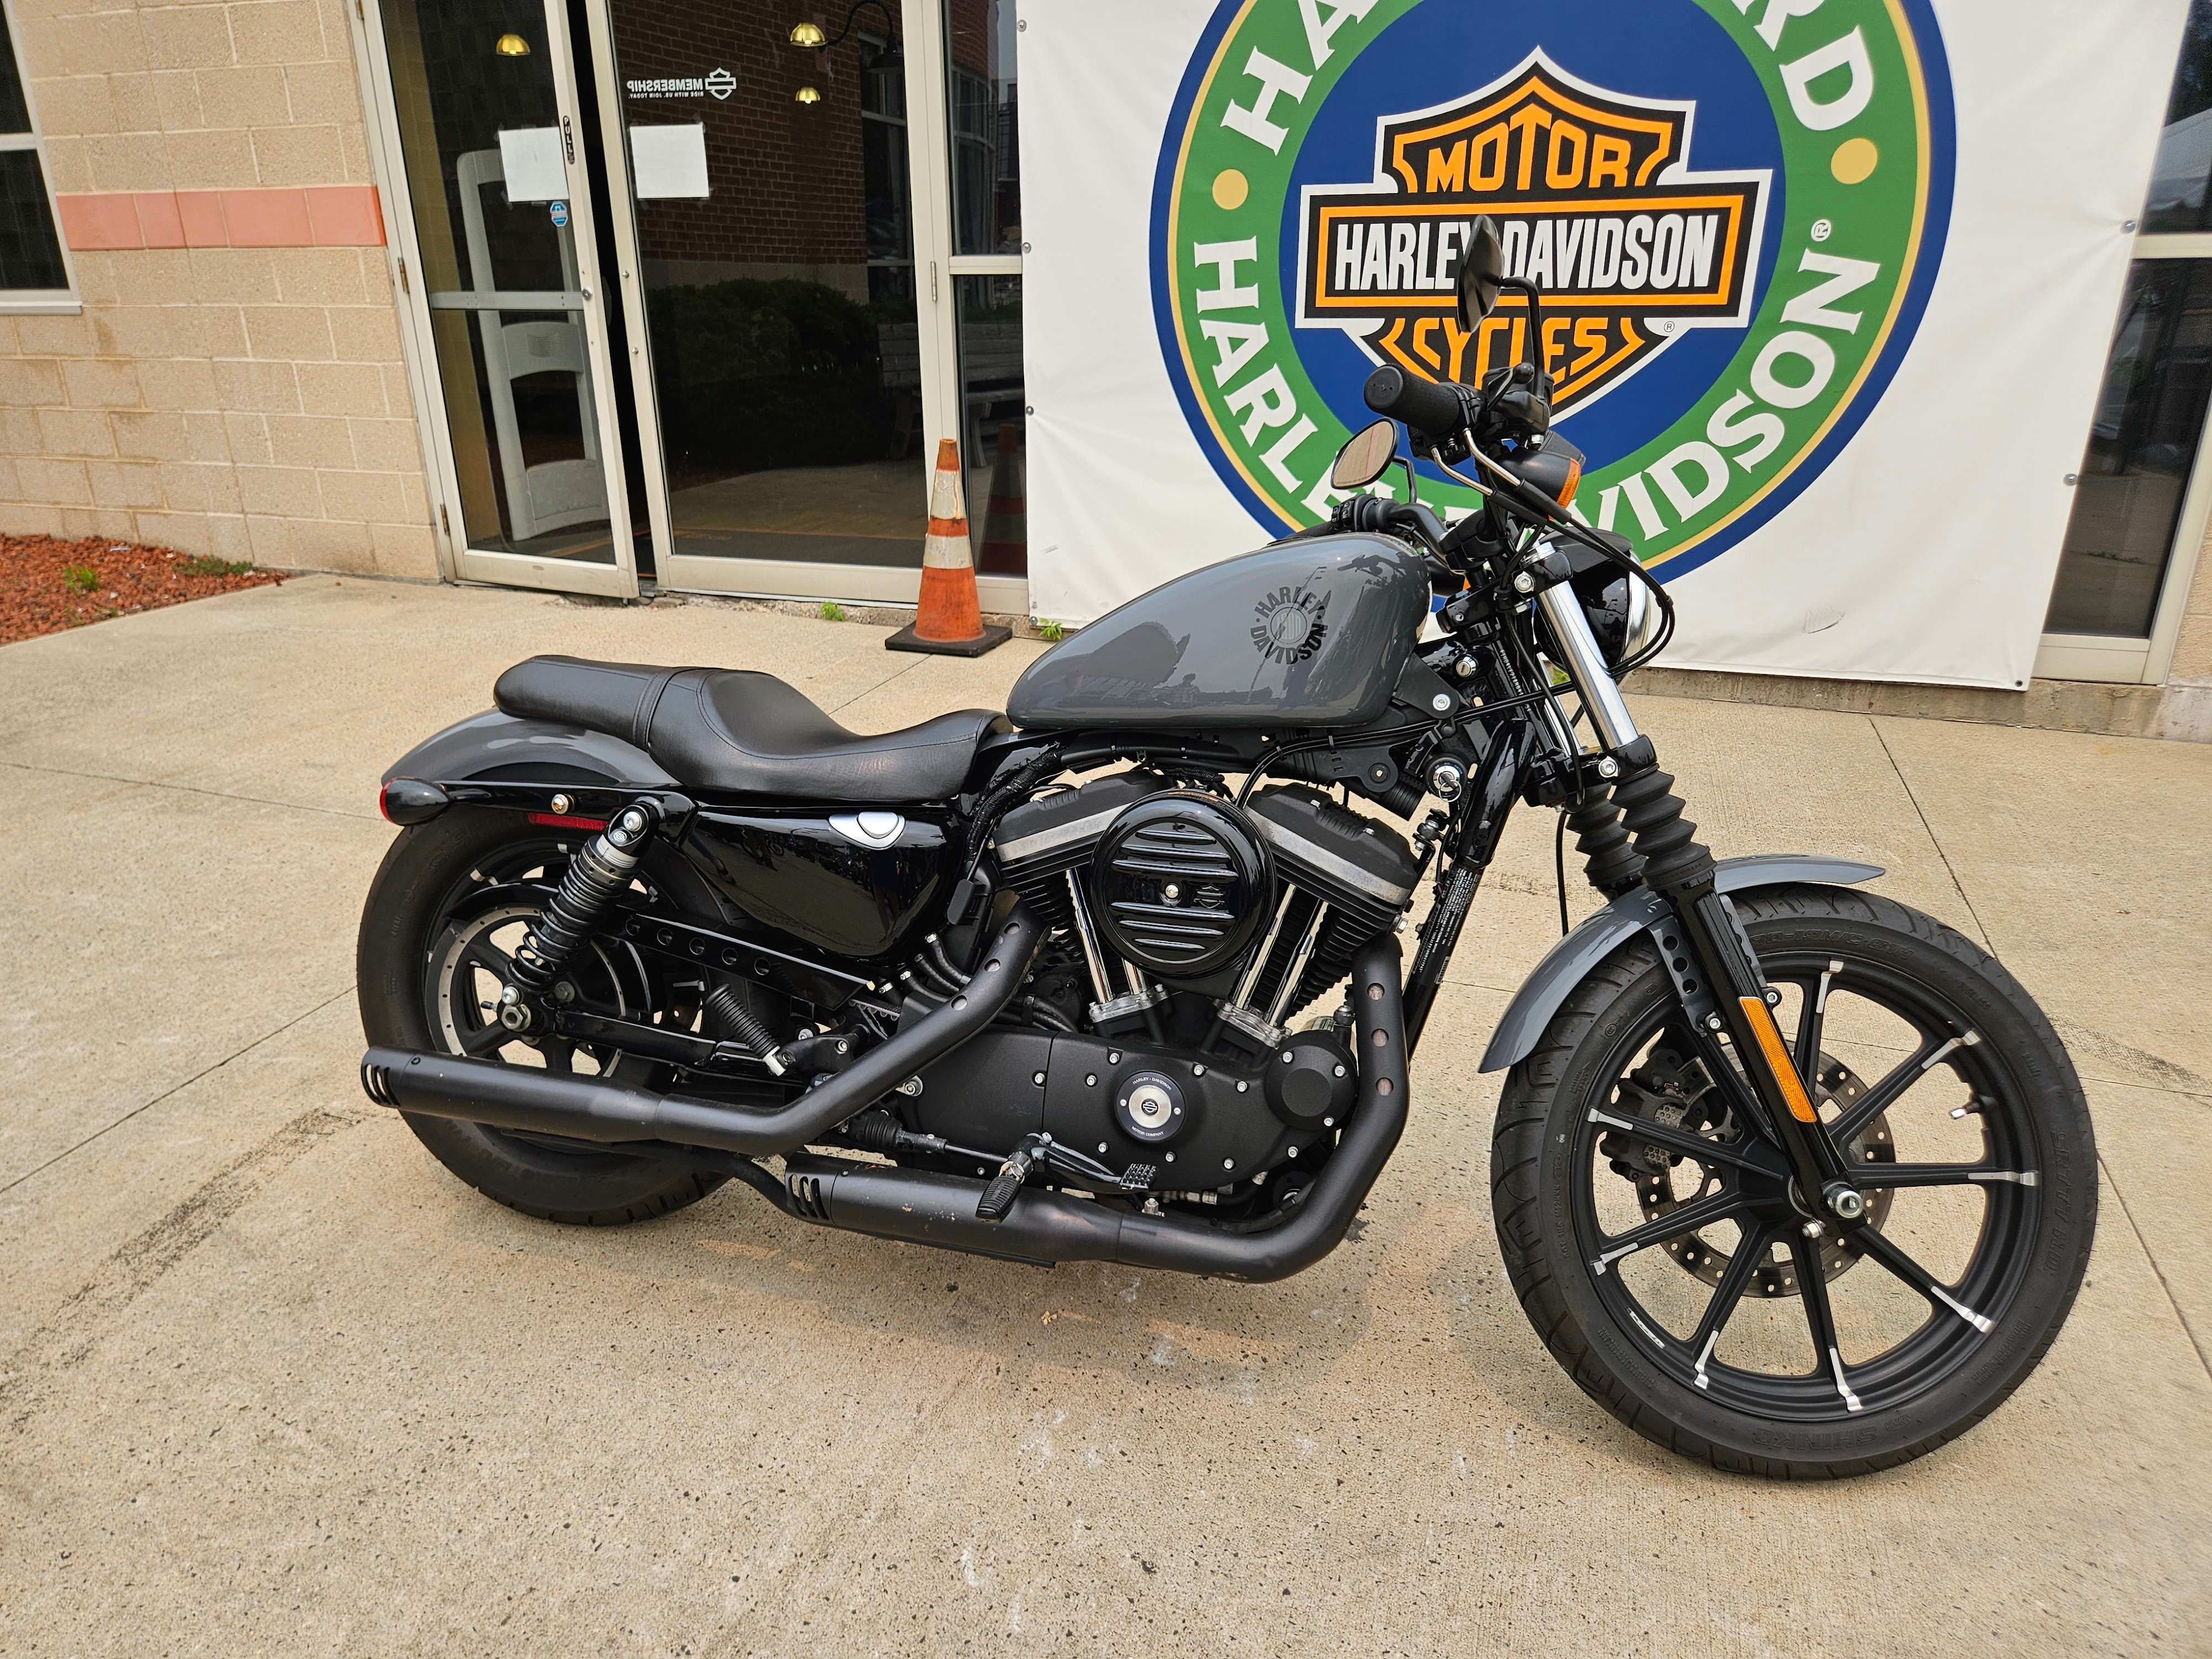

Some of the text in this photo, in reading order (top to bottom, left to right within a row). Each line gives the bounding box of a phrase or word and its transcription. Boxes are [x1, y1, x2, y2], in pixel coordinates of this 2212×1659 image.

[563, 116, 573, 153] PULL
[1425, 104, 1634, 192] MOTOR
[1334, 214, 1719, 291] HARLEDAVIDSON
[1254, 586, 1325, 619] HARLEY
[1250, 623, 1328, 665] DAVIDSON
